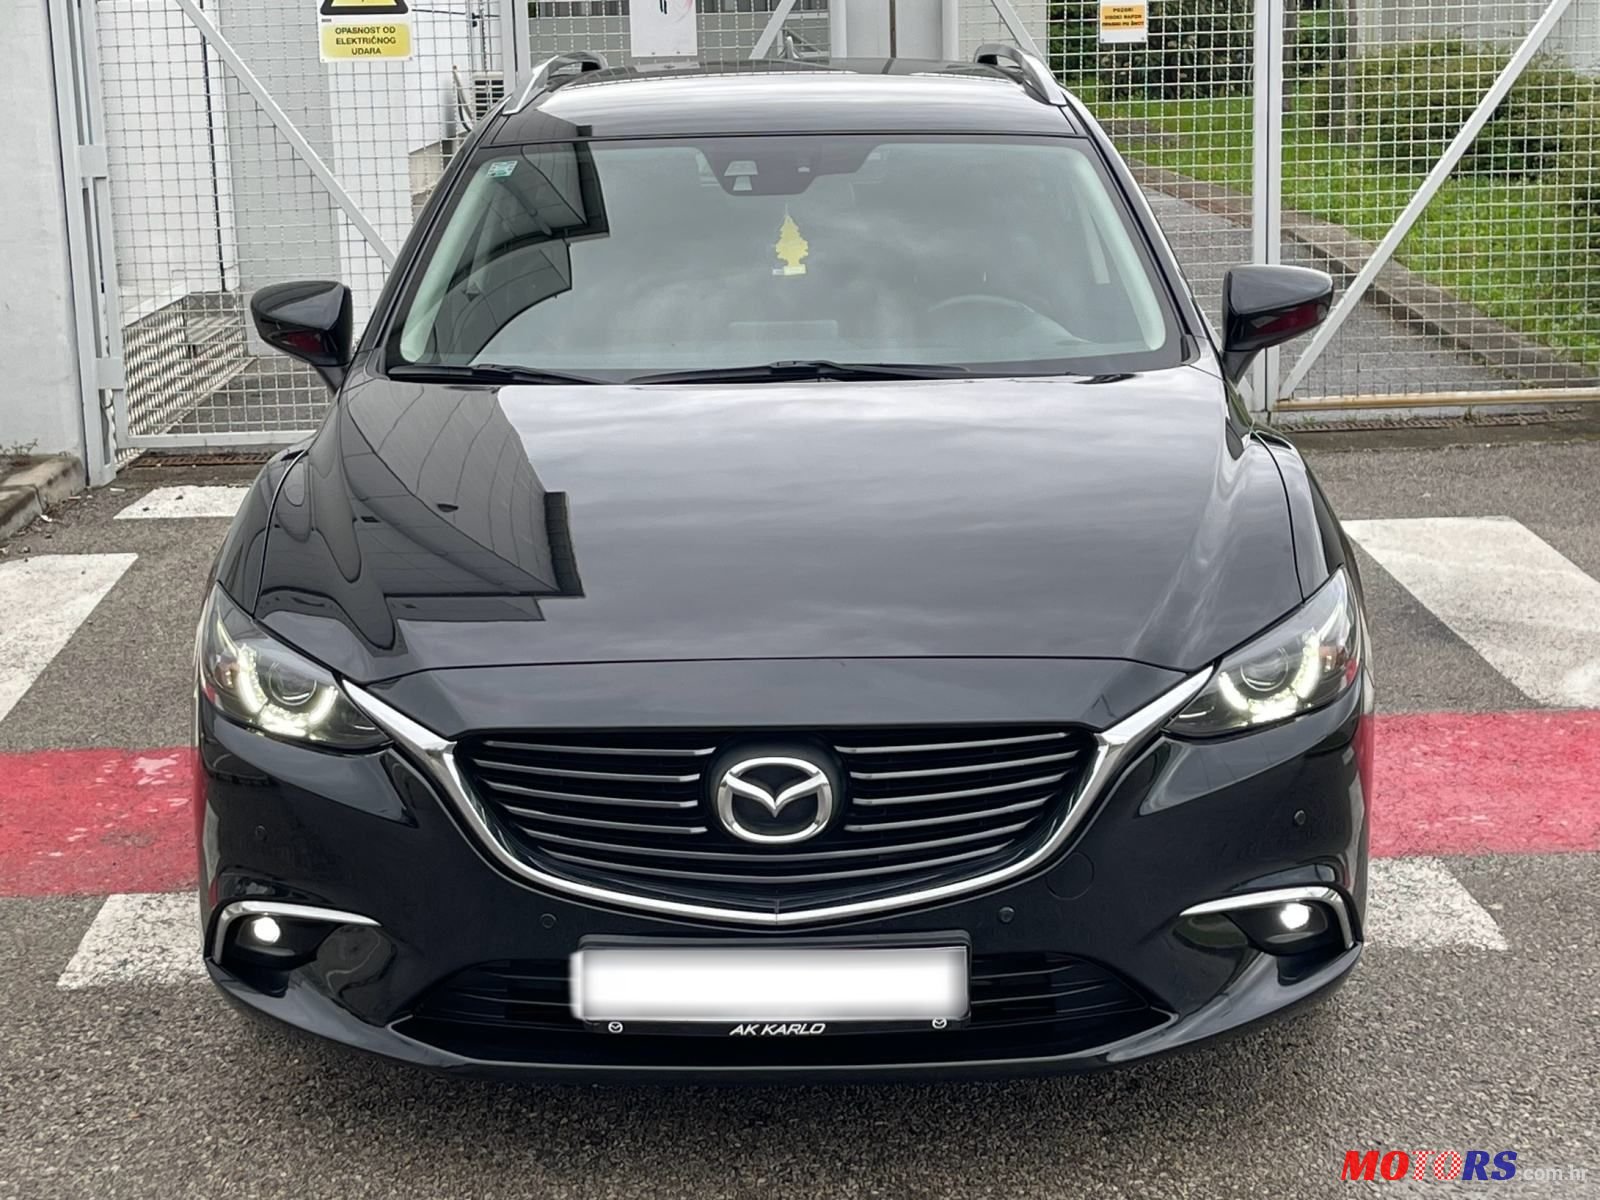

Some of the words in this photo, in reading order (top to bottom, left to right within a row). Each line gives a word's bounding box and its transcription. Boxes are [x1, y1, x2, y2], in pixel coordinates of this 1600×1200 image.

[335, 26, 380, 34] OPASNOST
[382, 26, 396, 34] OD
[335, 35, 396, 45] ELEKTRIČNOG
[351, 47, 382, 55] UDARA
[729, 1023, 760, 1036] AK
[760, 1022, 826, 1036] KARLO
